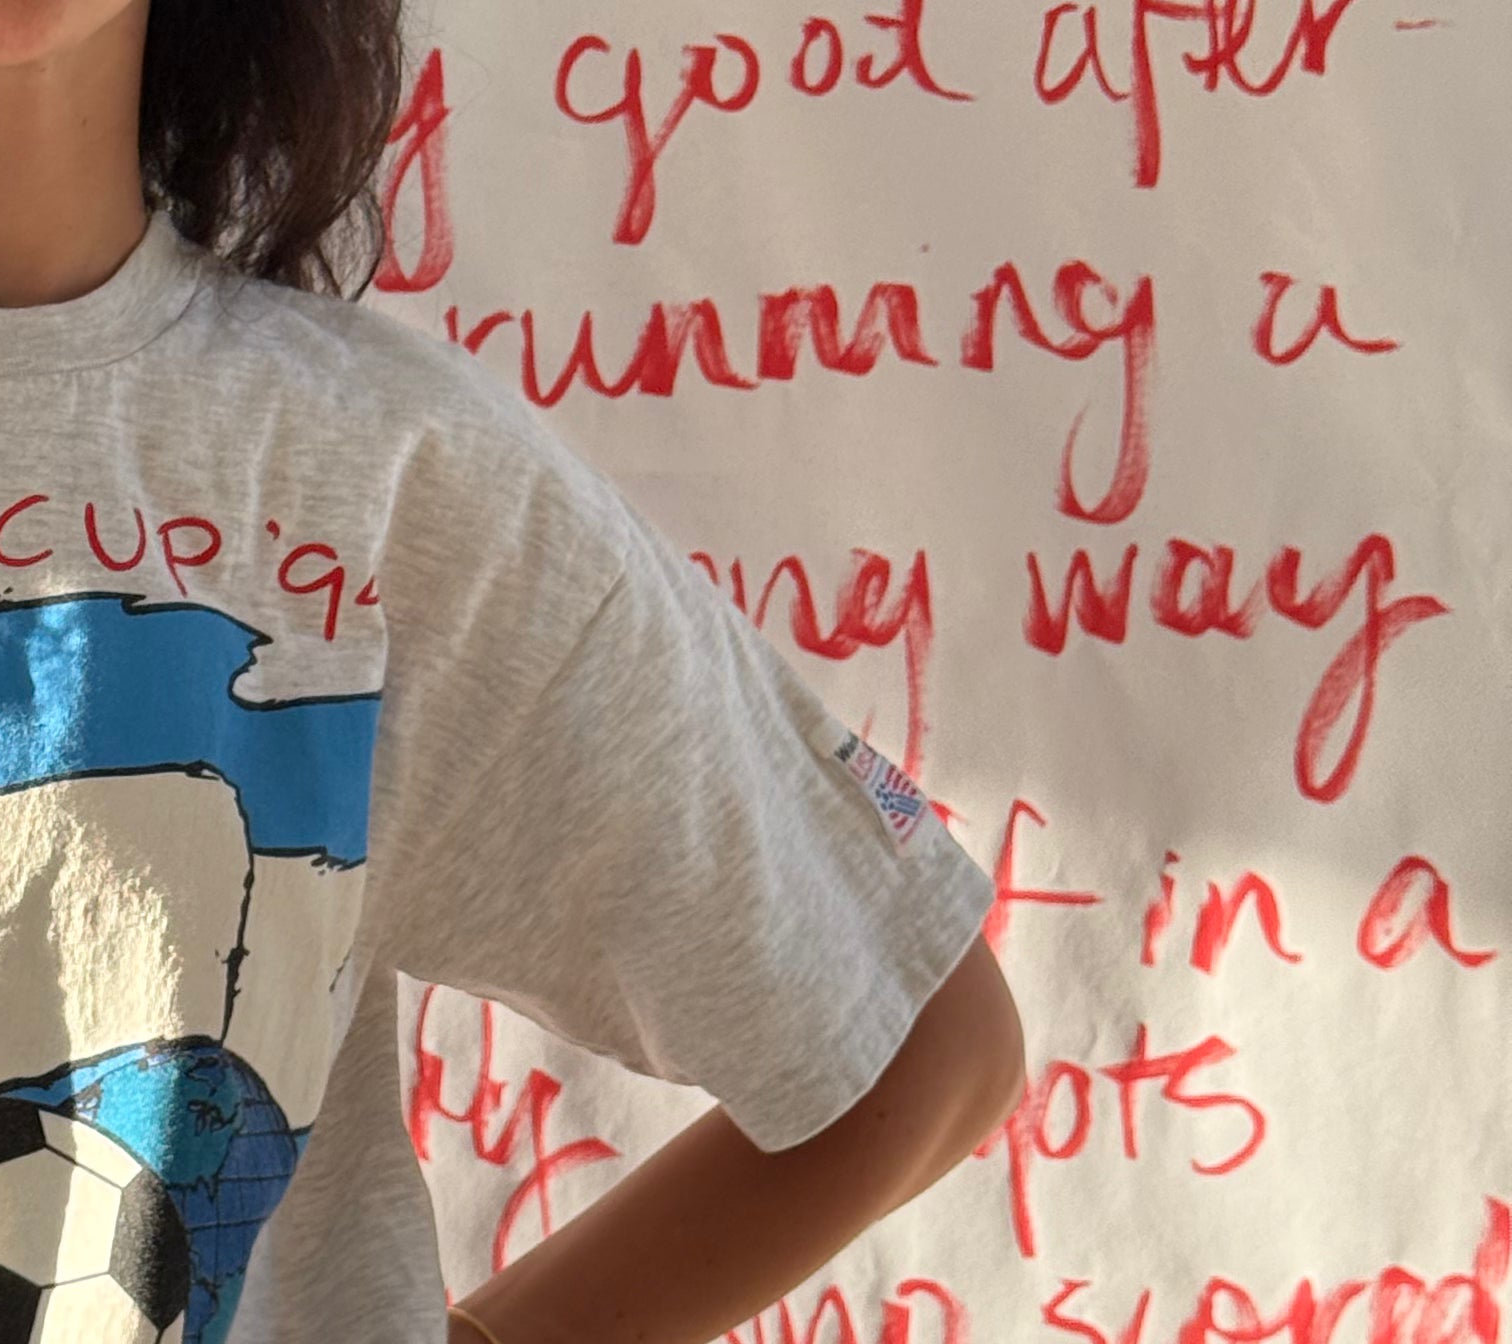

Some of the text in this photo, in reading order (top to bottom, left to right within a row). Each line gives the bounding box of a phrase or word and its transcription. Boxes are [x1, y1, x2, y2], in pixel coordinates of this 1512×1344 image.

[1250, 271, 1400, 366] a
[1023, 534, 1450, 803] way
[1140, 849, 1300, 972] in
[1358, 856, 1496, 968] a
